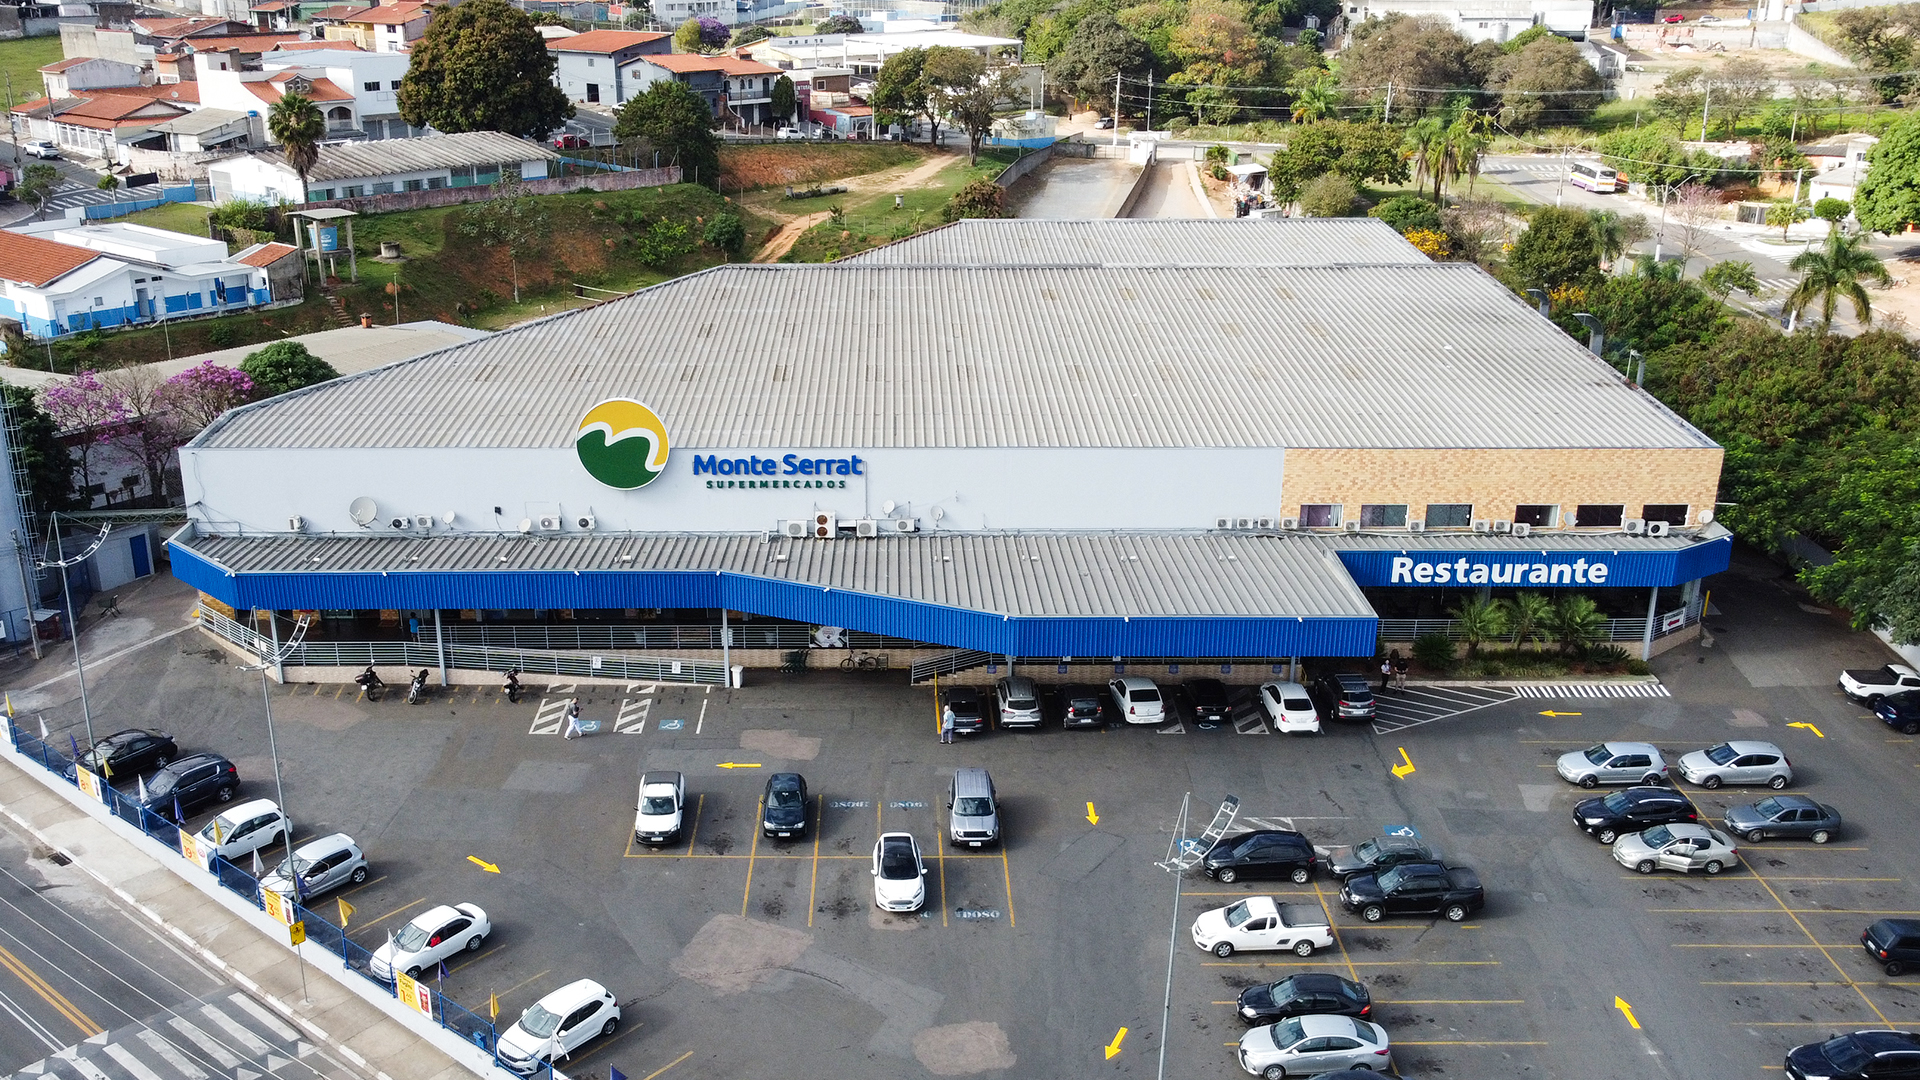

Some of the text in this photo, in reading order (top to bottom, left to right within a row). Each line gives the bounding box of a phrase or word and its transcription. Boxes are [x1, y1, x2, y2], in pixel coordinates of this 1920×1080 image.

[693, 453, 863, 476] Monte Serrat
[706, 480, 846, 489] SUPERMERCADOS
[1391, 556, 1608, 584] Restaurante
